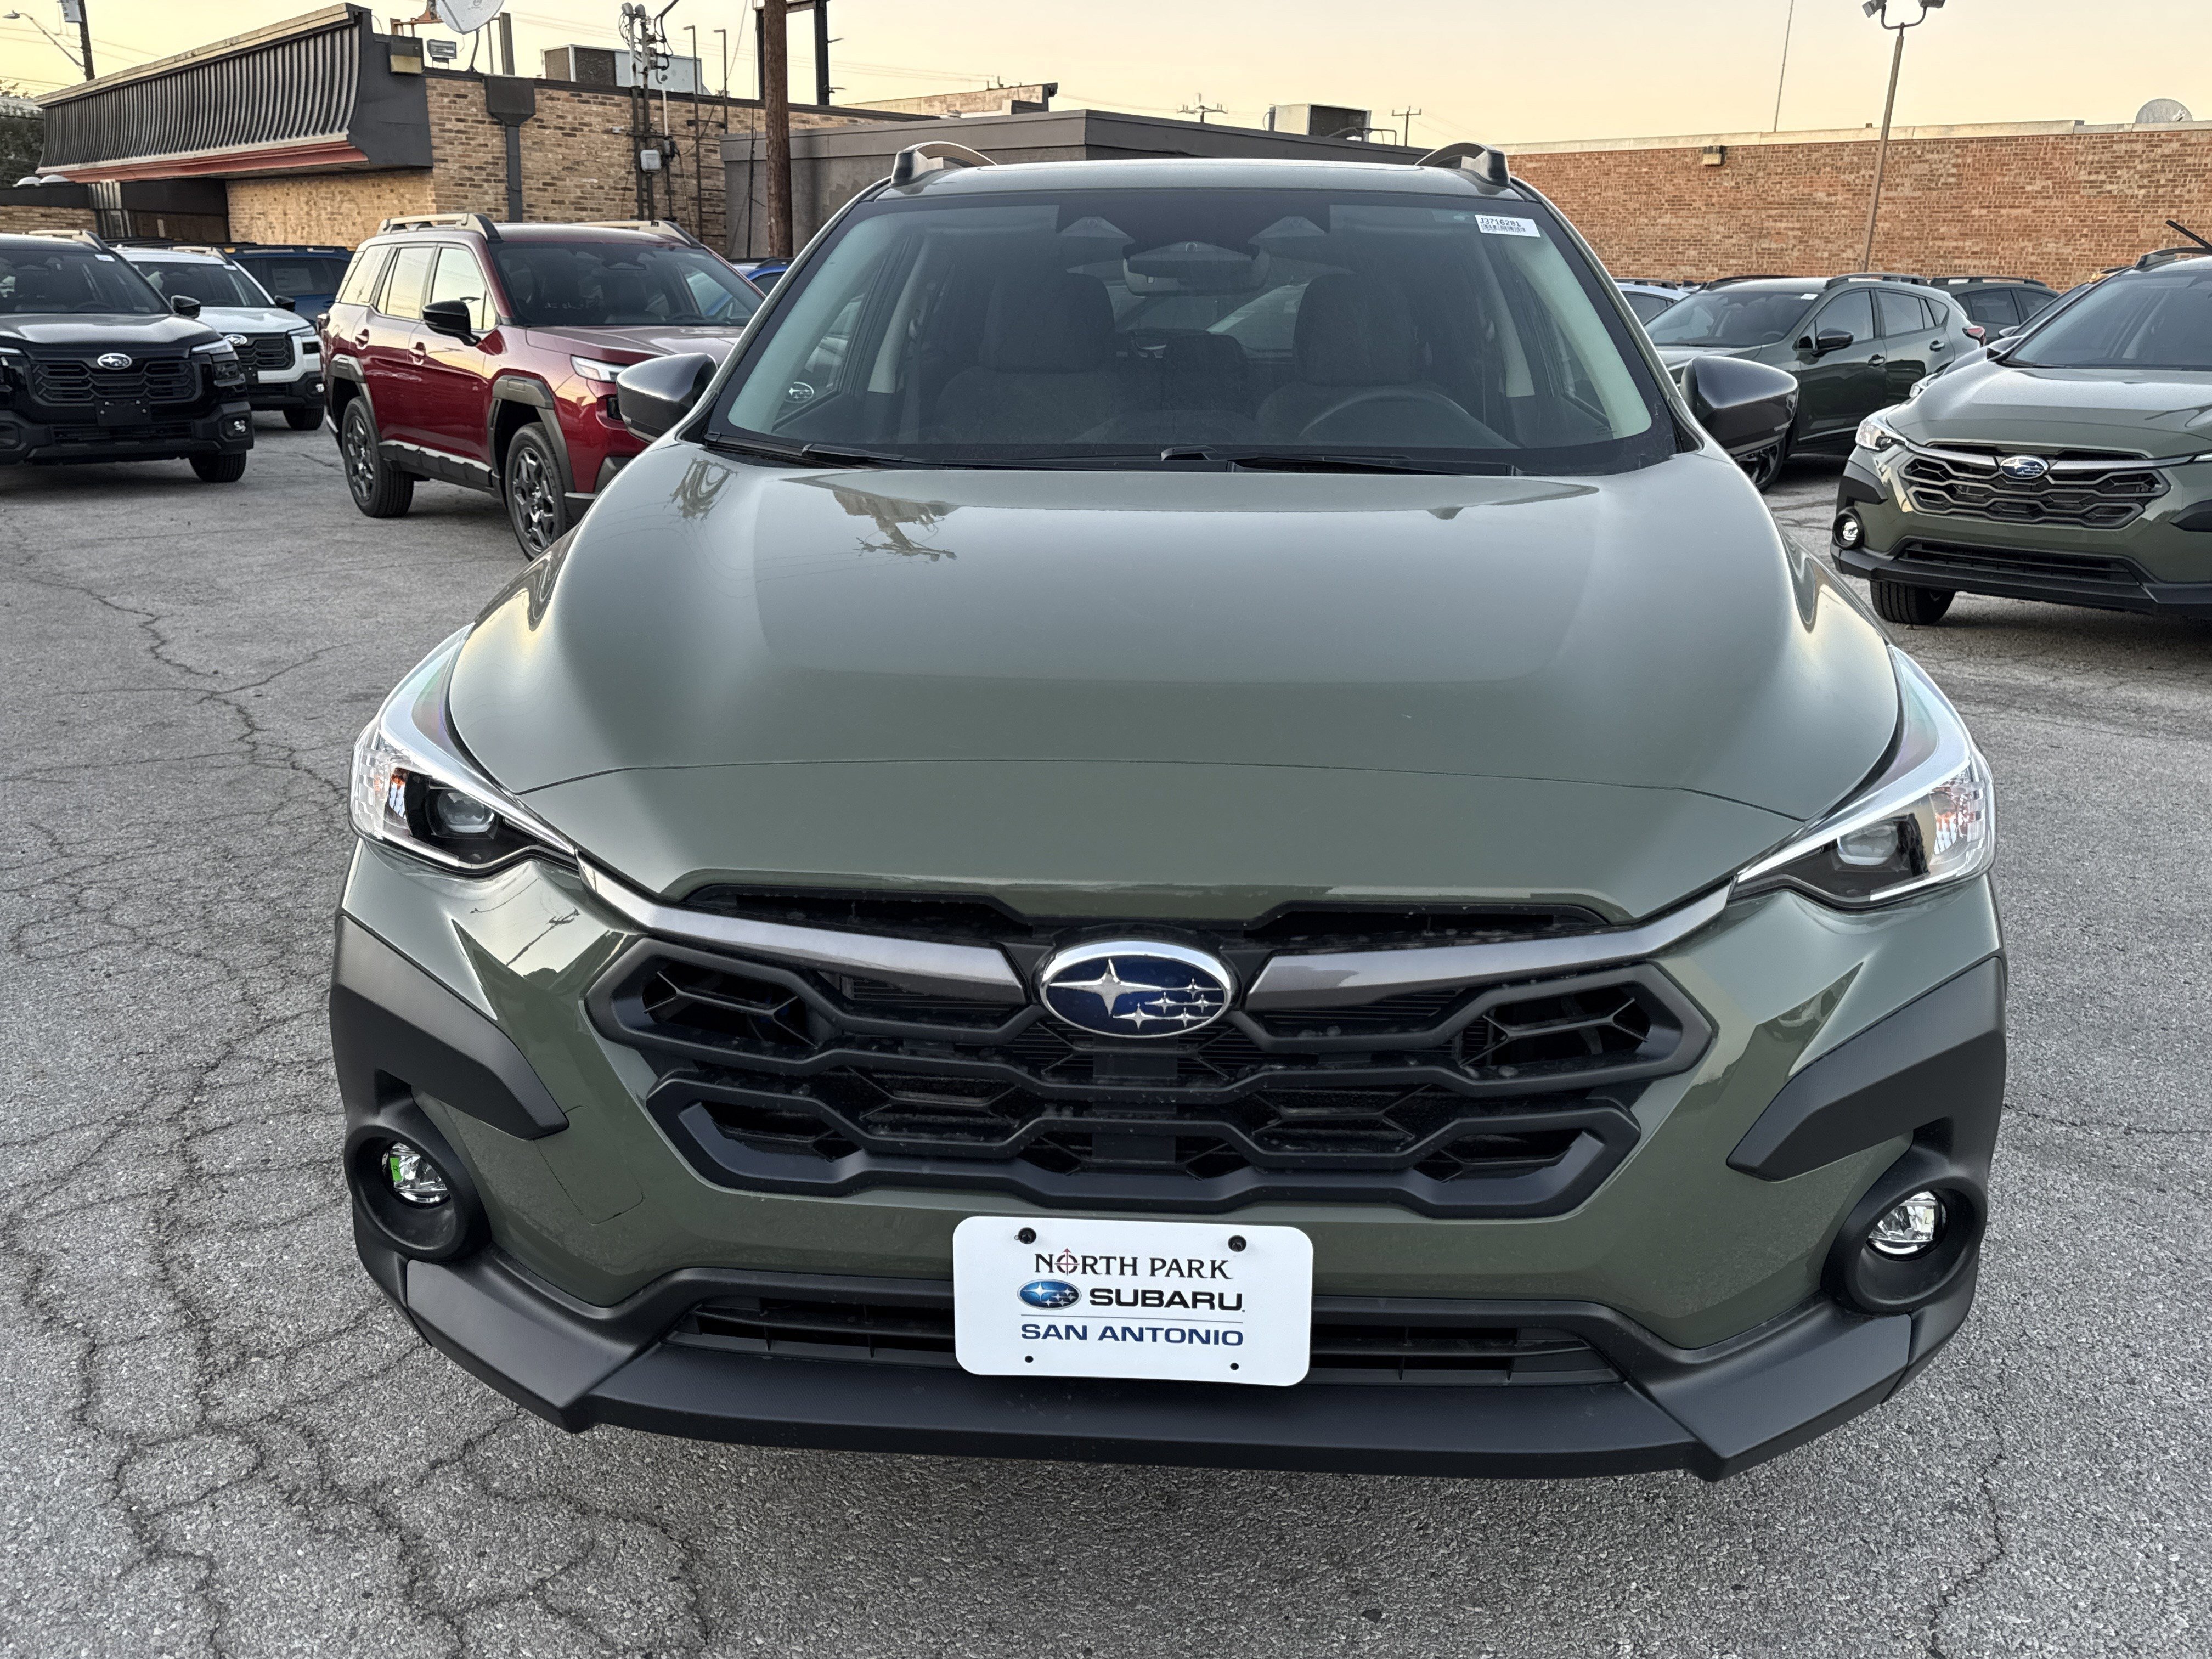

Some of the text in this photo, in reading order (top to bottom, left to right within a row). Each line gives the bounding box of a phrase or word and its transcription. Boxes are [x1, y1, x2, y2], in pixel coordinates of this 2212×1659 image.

[1480, 218, 1521, 227] J3716281
[1034, 1251, 1234, 1279] NORTH PARK
[1020, 1323, 1244, 1346] SAN ANTONIO
